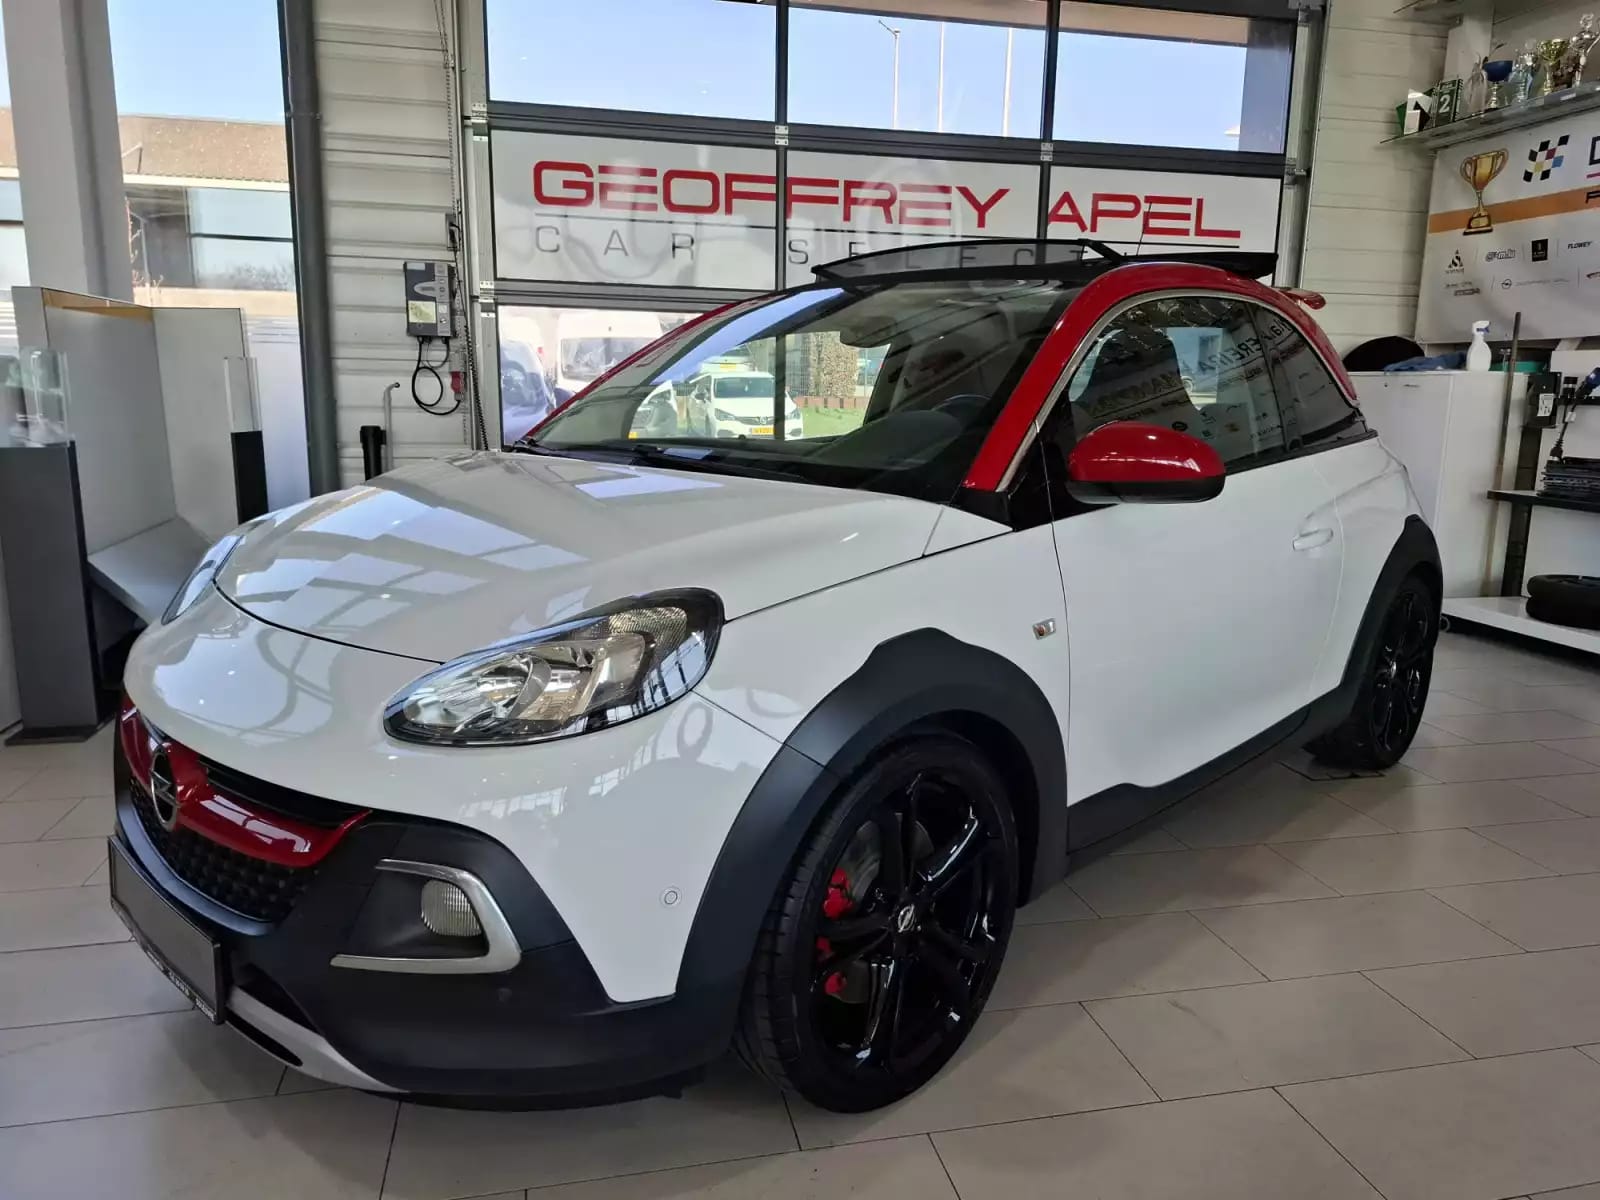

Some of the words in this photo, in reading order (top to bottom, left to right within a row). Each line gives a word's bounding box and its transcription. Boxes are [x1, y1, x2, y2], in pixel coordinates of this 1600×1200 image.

[533, 160, 1011, 229] GEOFFREY
[1047, 190, 1241, 239] APEL
[534, 224, 696, 262] CAR
